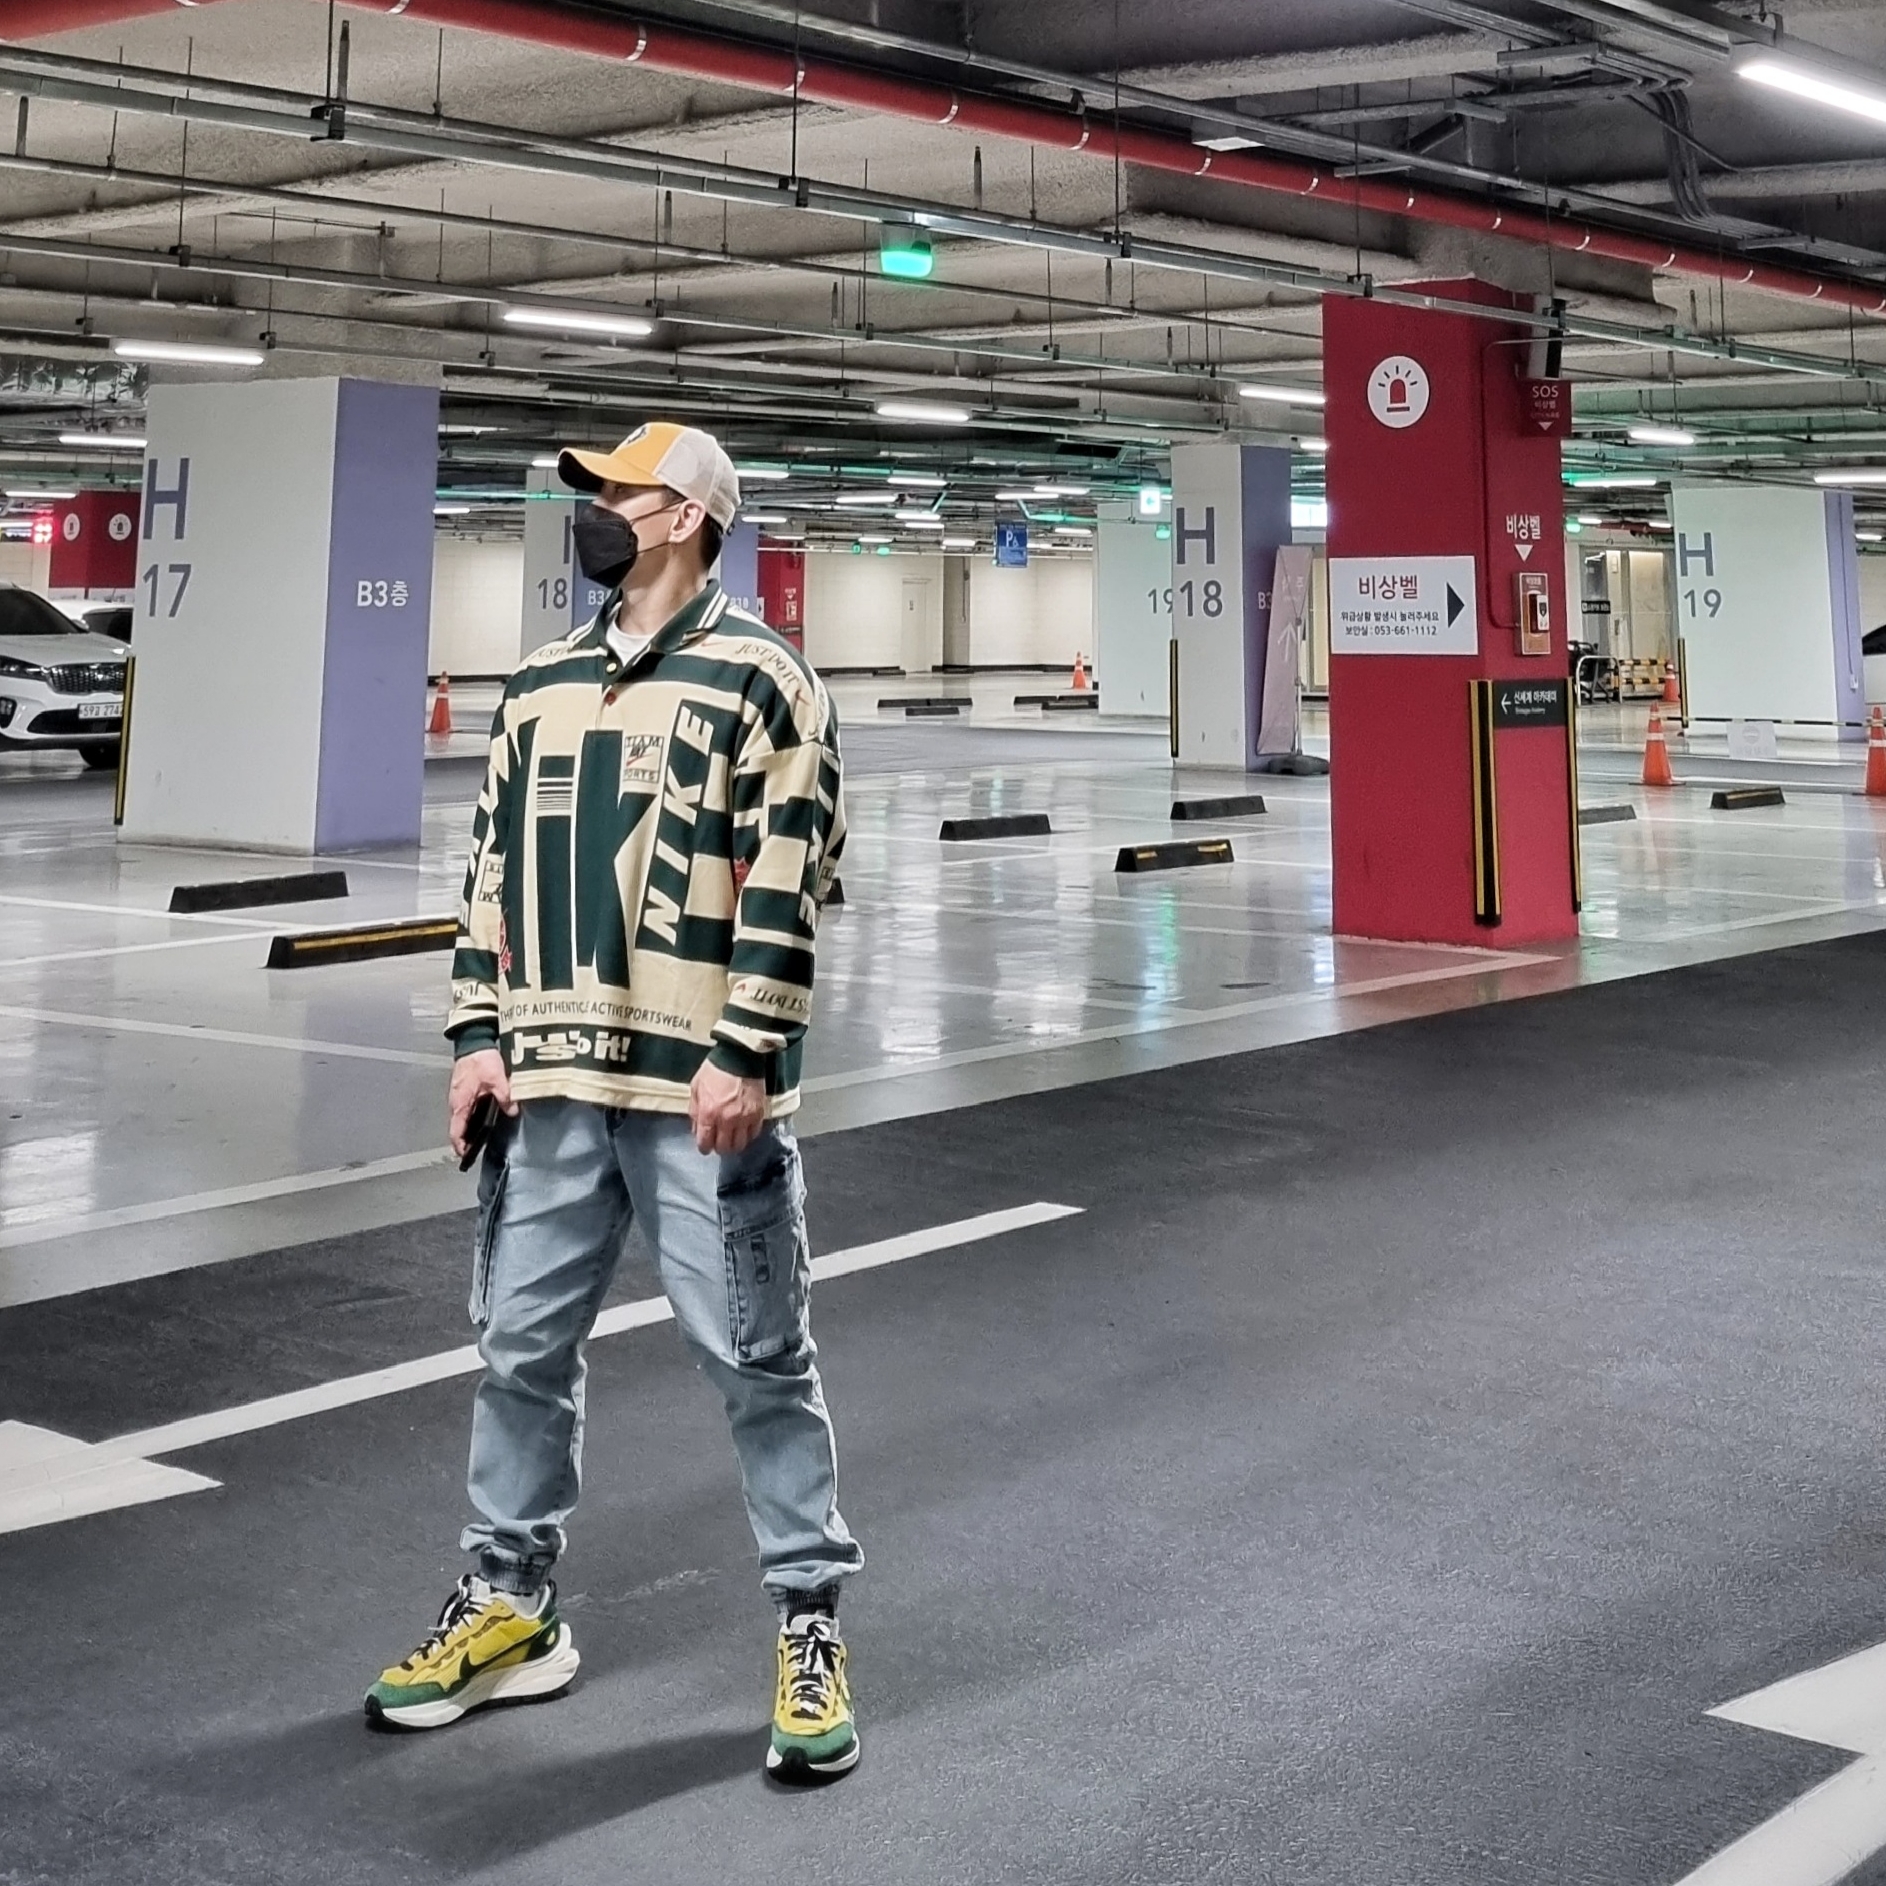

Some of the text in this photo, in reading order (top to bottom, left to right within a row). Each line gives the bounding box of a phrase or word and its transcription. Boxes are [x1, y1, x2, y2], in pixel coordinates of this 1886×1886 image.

[1532, 385, 1559, 398] SOS
[143, 457, 190, 540] H
[1176, 506, 1216, 565] H
[1505, 513, 1541, 540] 비상벨
[1678, 532, 1714, 577] H
[142, 563, 192, 618] 17
[356, 580, 409, 608] B3층
[537, 577, 568, 610] 18
[588, 589, 612, 606] B3
[1179, 580, 1223, 618] 18
[1358, 575, 1418, 600] 비상벨
[1683, 588, 1722, 618] 19
[1374, 625, 1437, 636] 053-661-1112
[643, 705, 714, 946] NIKE
[515, 1004, 528, 1016] OF
